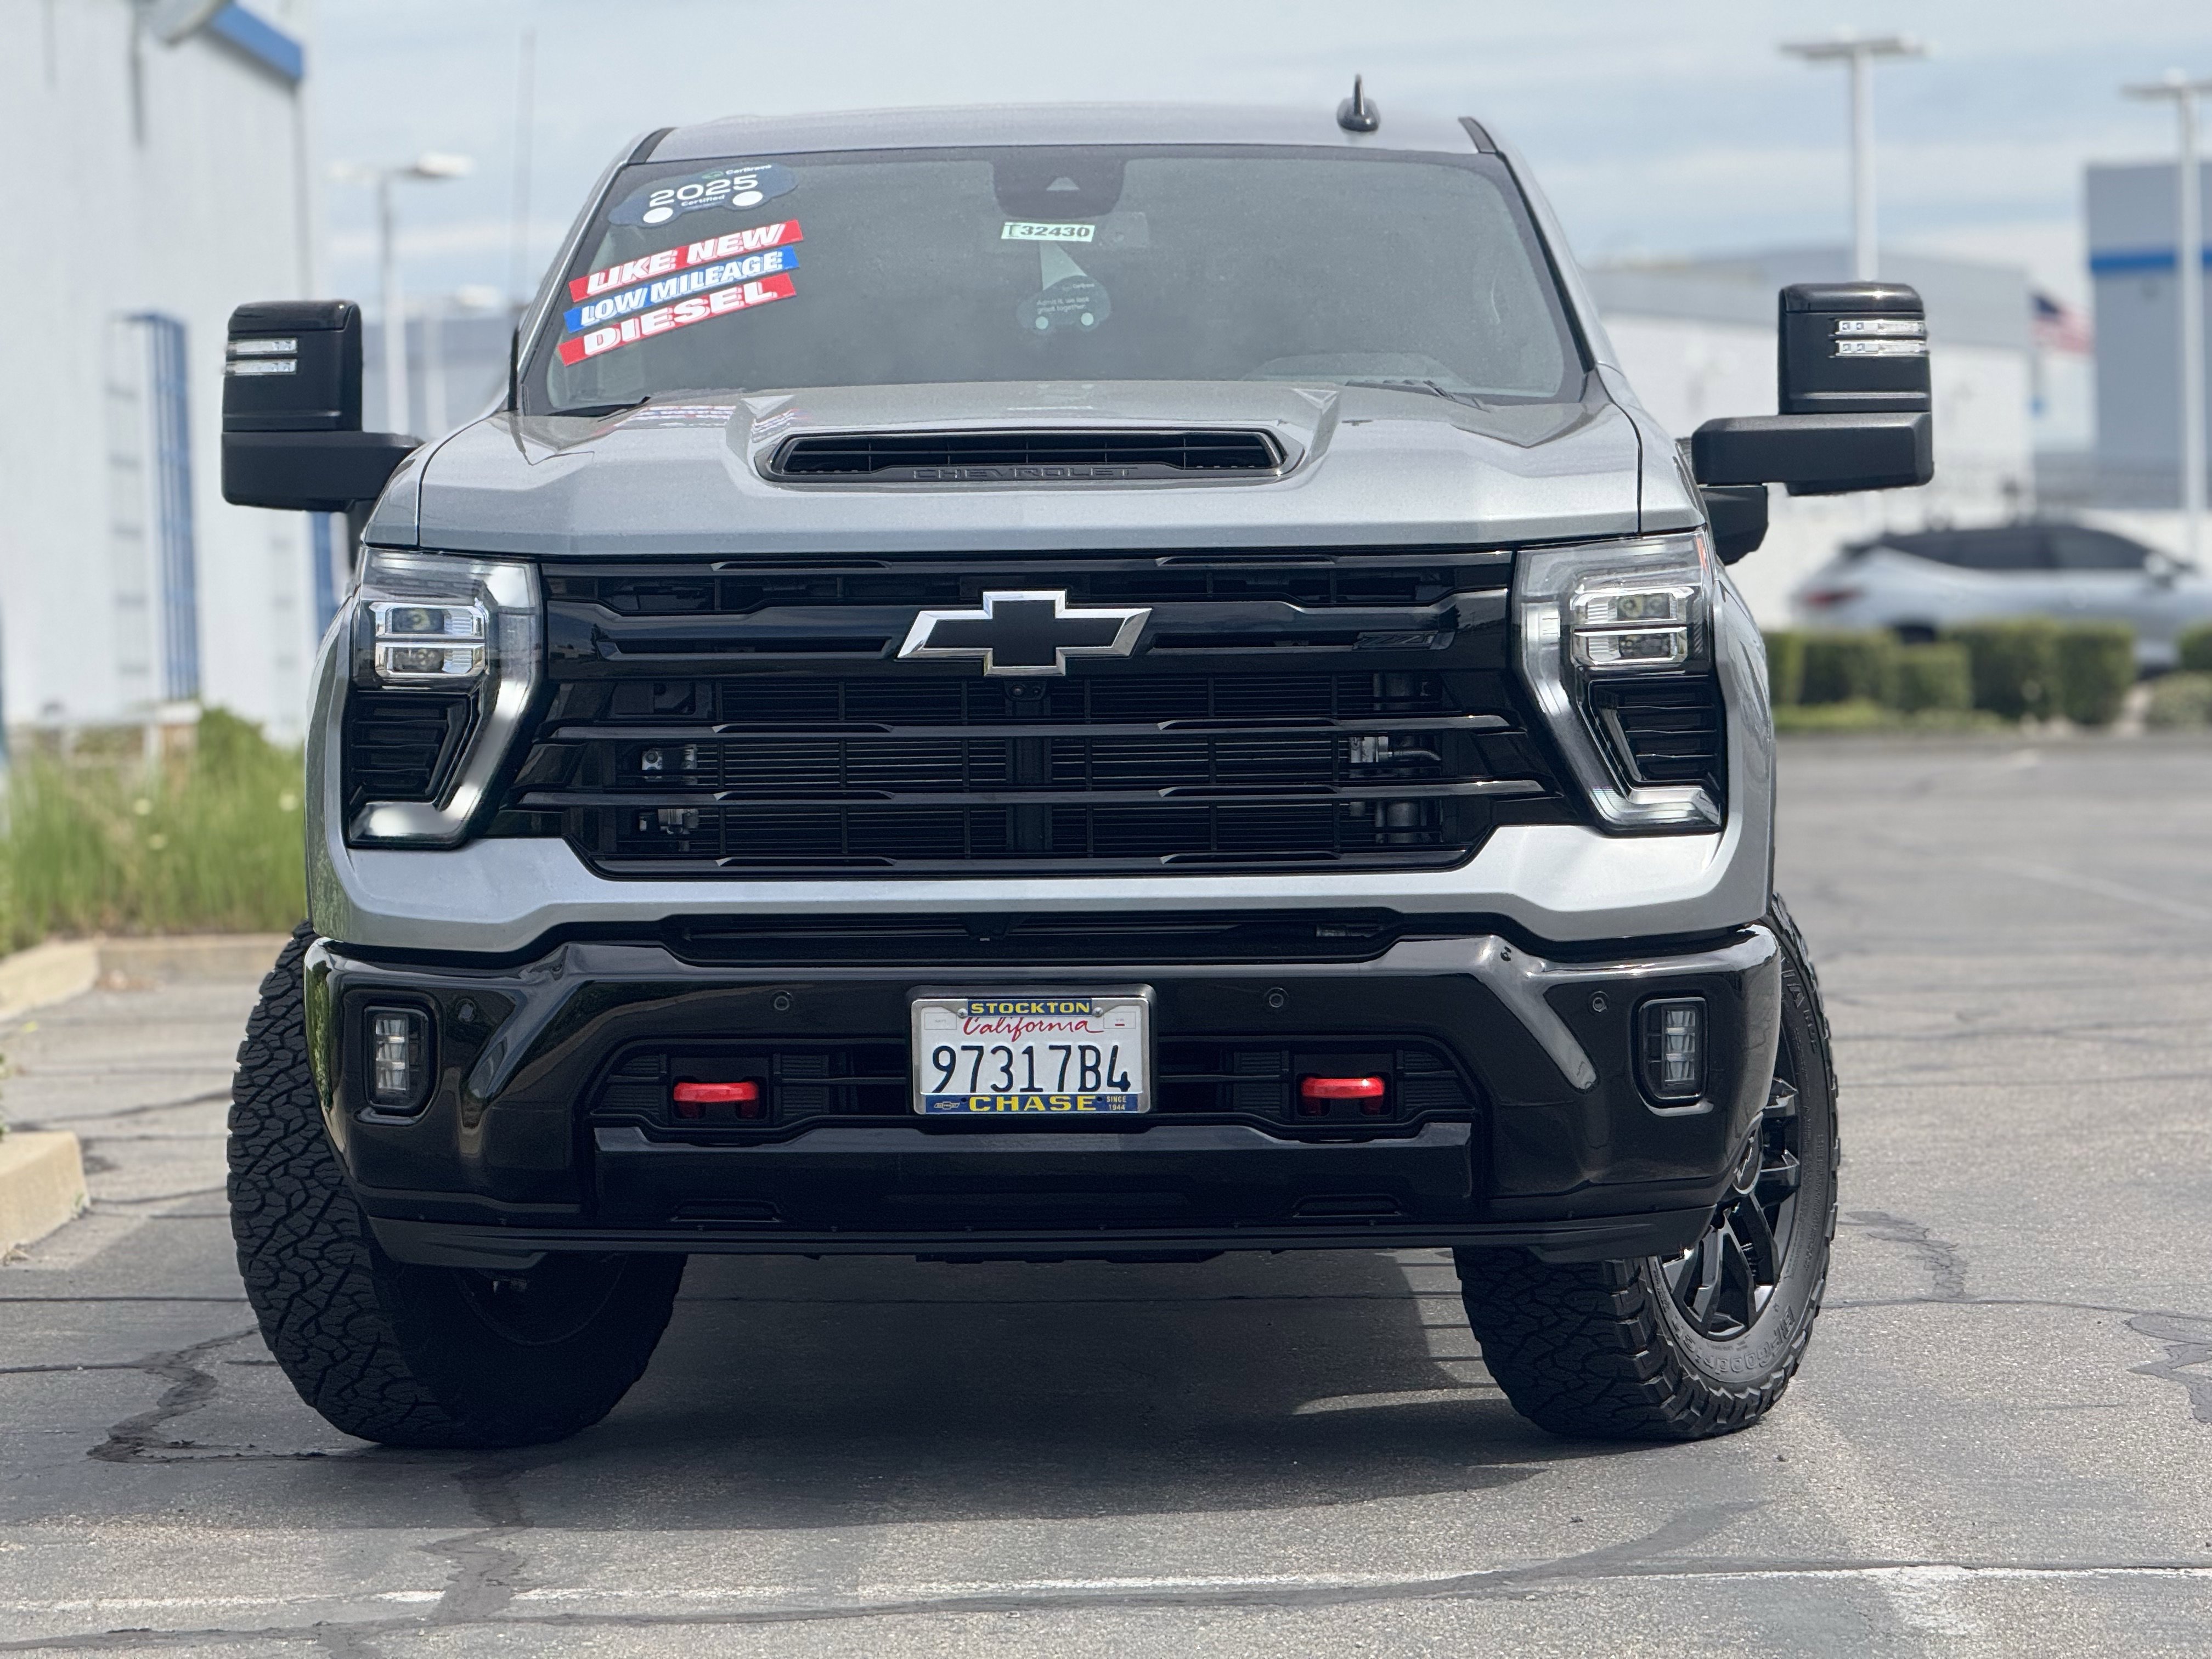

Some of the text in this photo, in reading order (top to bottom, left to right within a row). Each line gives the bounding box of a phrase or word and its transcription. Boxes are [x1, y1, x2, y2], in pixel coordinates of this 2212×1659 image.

[649, 174, 758, 207] 2025
[681, 194, 725, 206] Certified
[586, 223, 786, 295] LIKE NEW
[581, 251, 783, 326] LOW MILEAGE
[584, 281, 778, 356] DIESEL
[913, 467, 1138, 478] CHEVROLET
[970, 1002, 1090, 1014] STOCKTON
[963, 1017, 1104, 1042] California
[932, 1045, 1131, 1093] 97317B4
[969, 1096, 1096, 1111] CHASE
